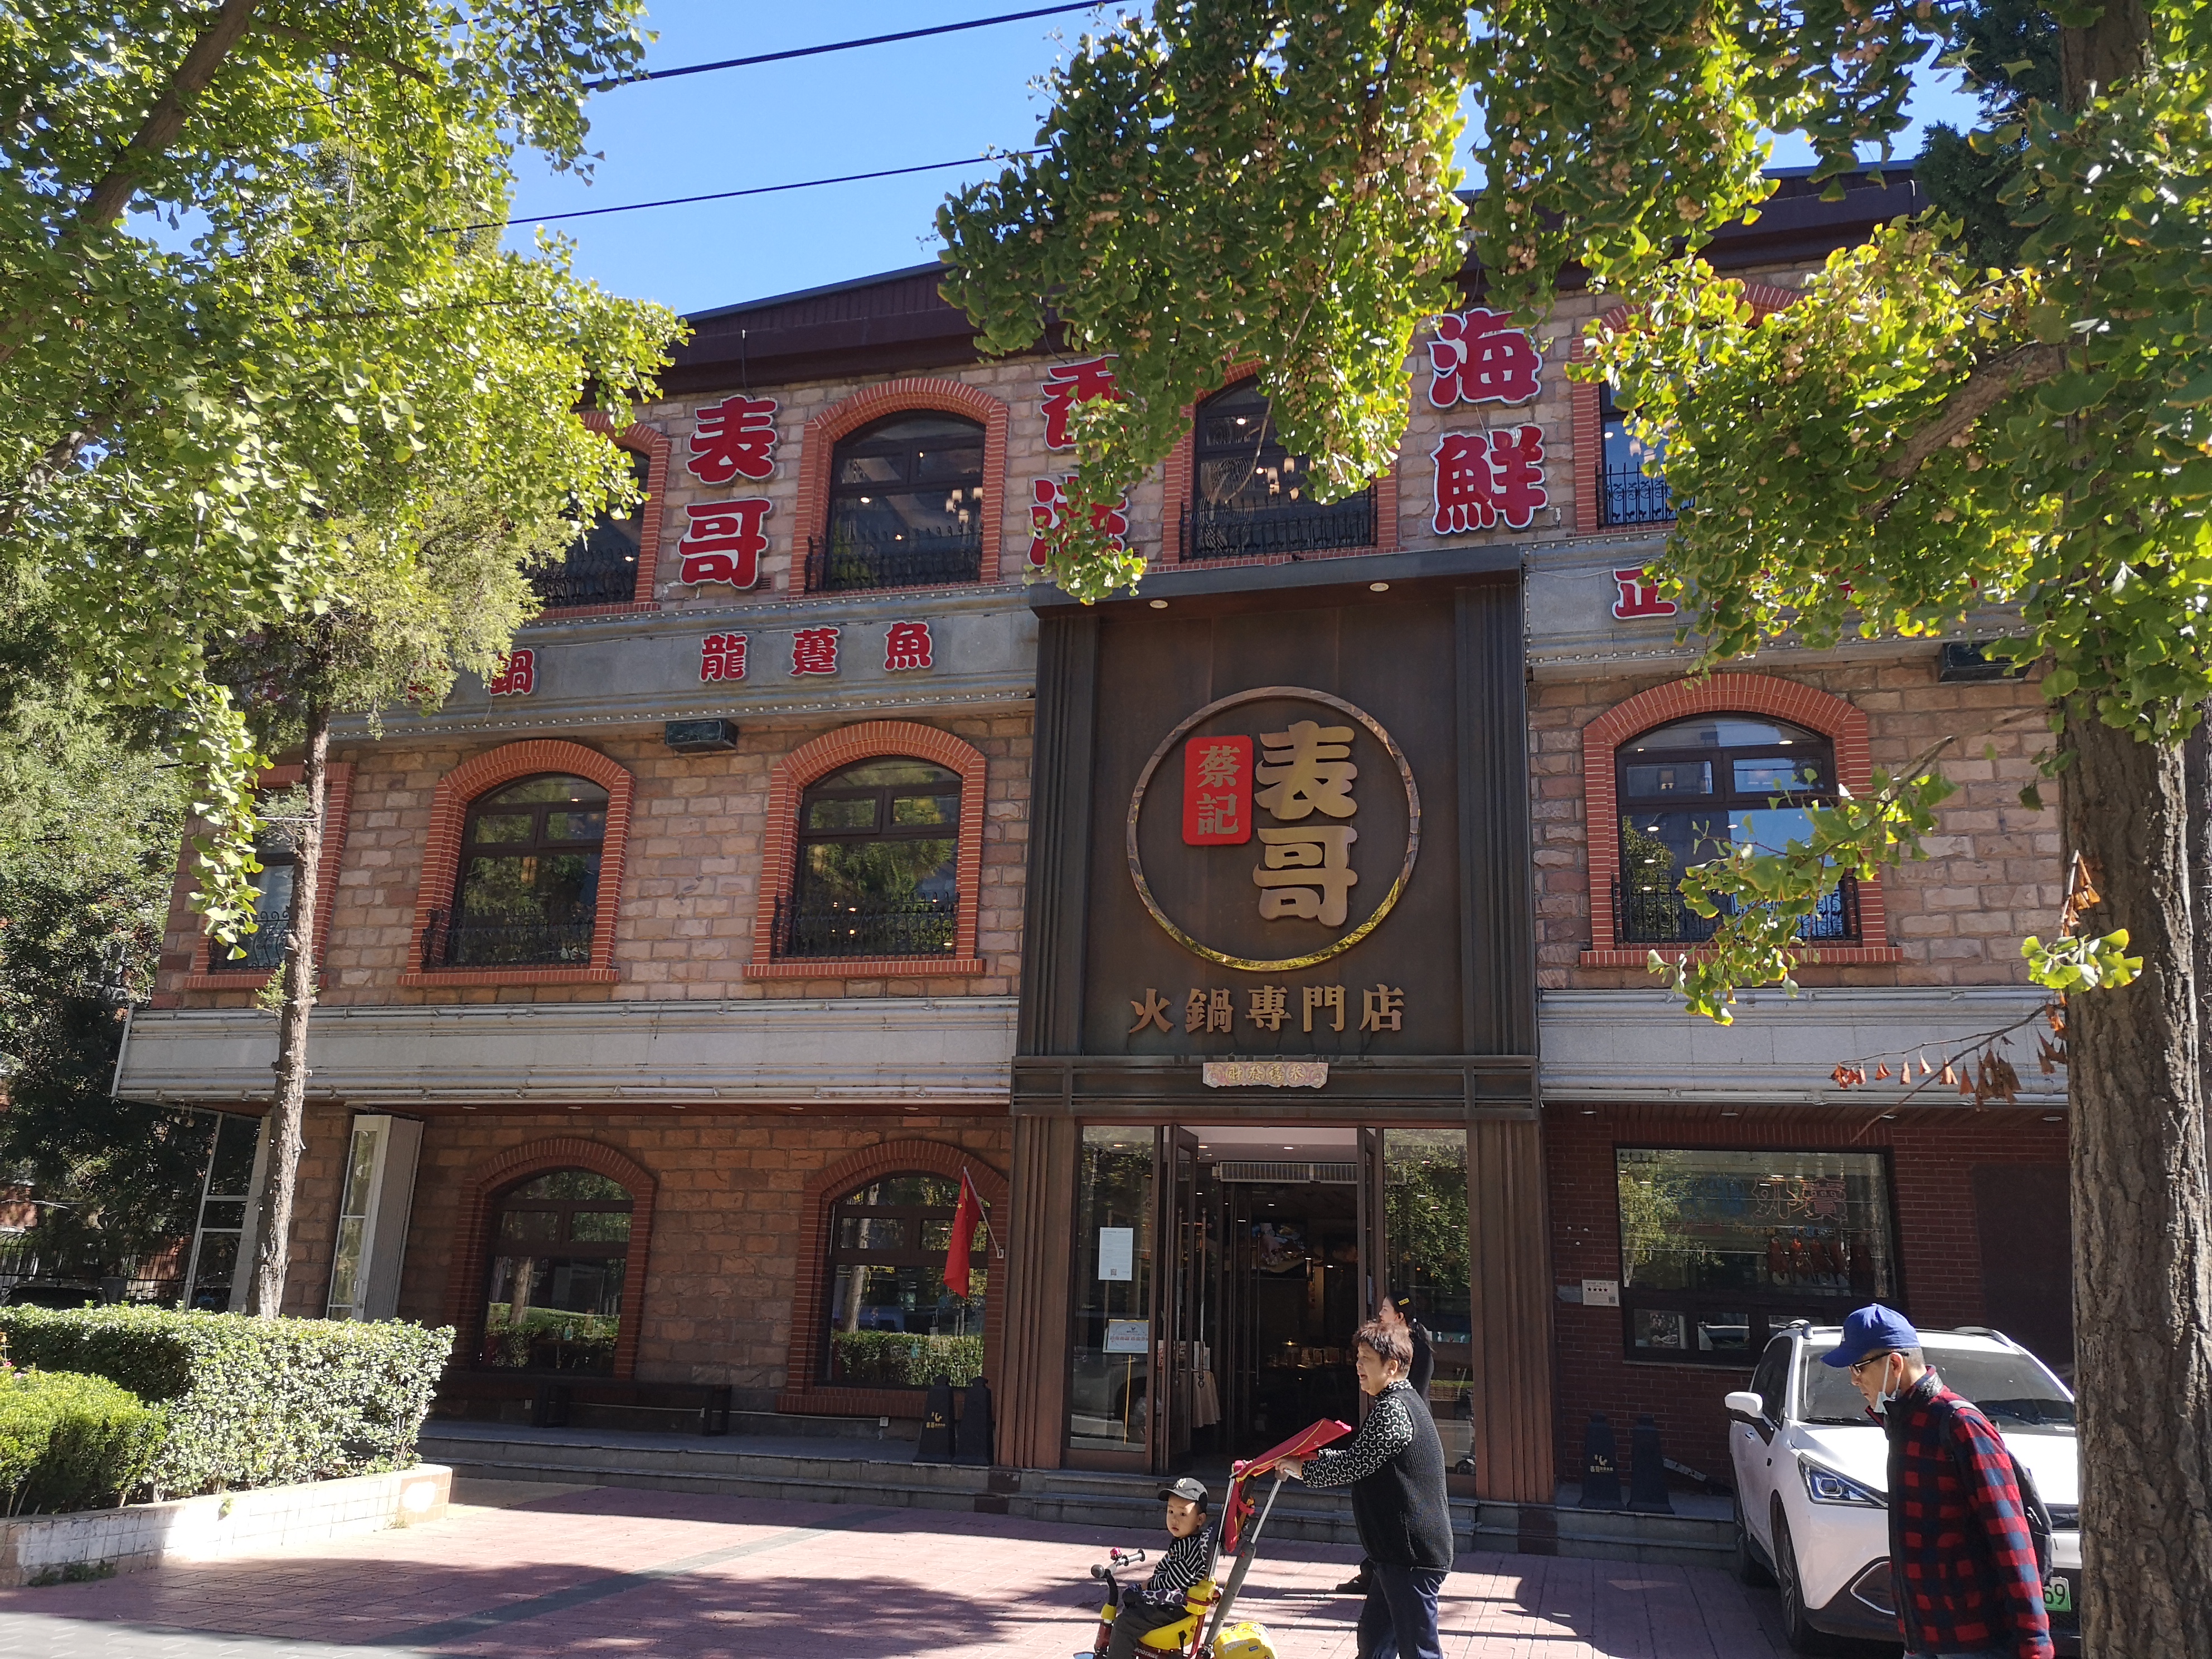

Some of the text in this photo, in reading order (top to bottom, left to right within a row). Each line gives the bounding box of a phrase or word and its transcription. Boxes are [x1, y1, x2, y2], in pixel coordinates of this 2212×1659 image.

[677, 395, 777, 590] 表哥
[1427, 307, 1548, 535] 海鮮
[1197, 745, 1240, 836] 蔡記
[1253, 720, 1358, 926] 表哥
[1128, 984, 1405, 1033] 火鍋專門店
